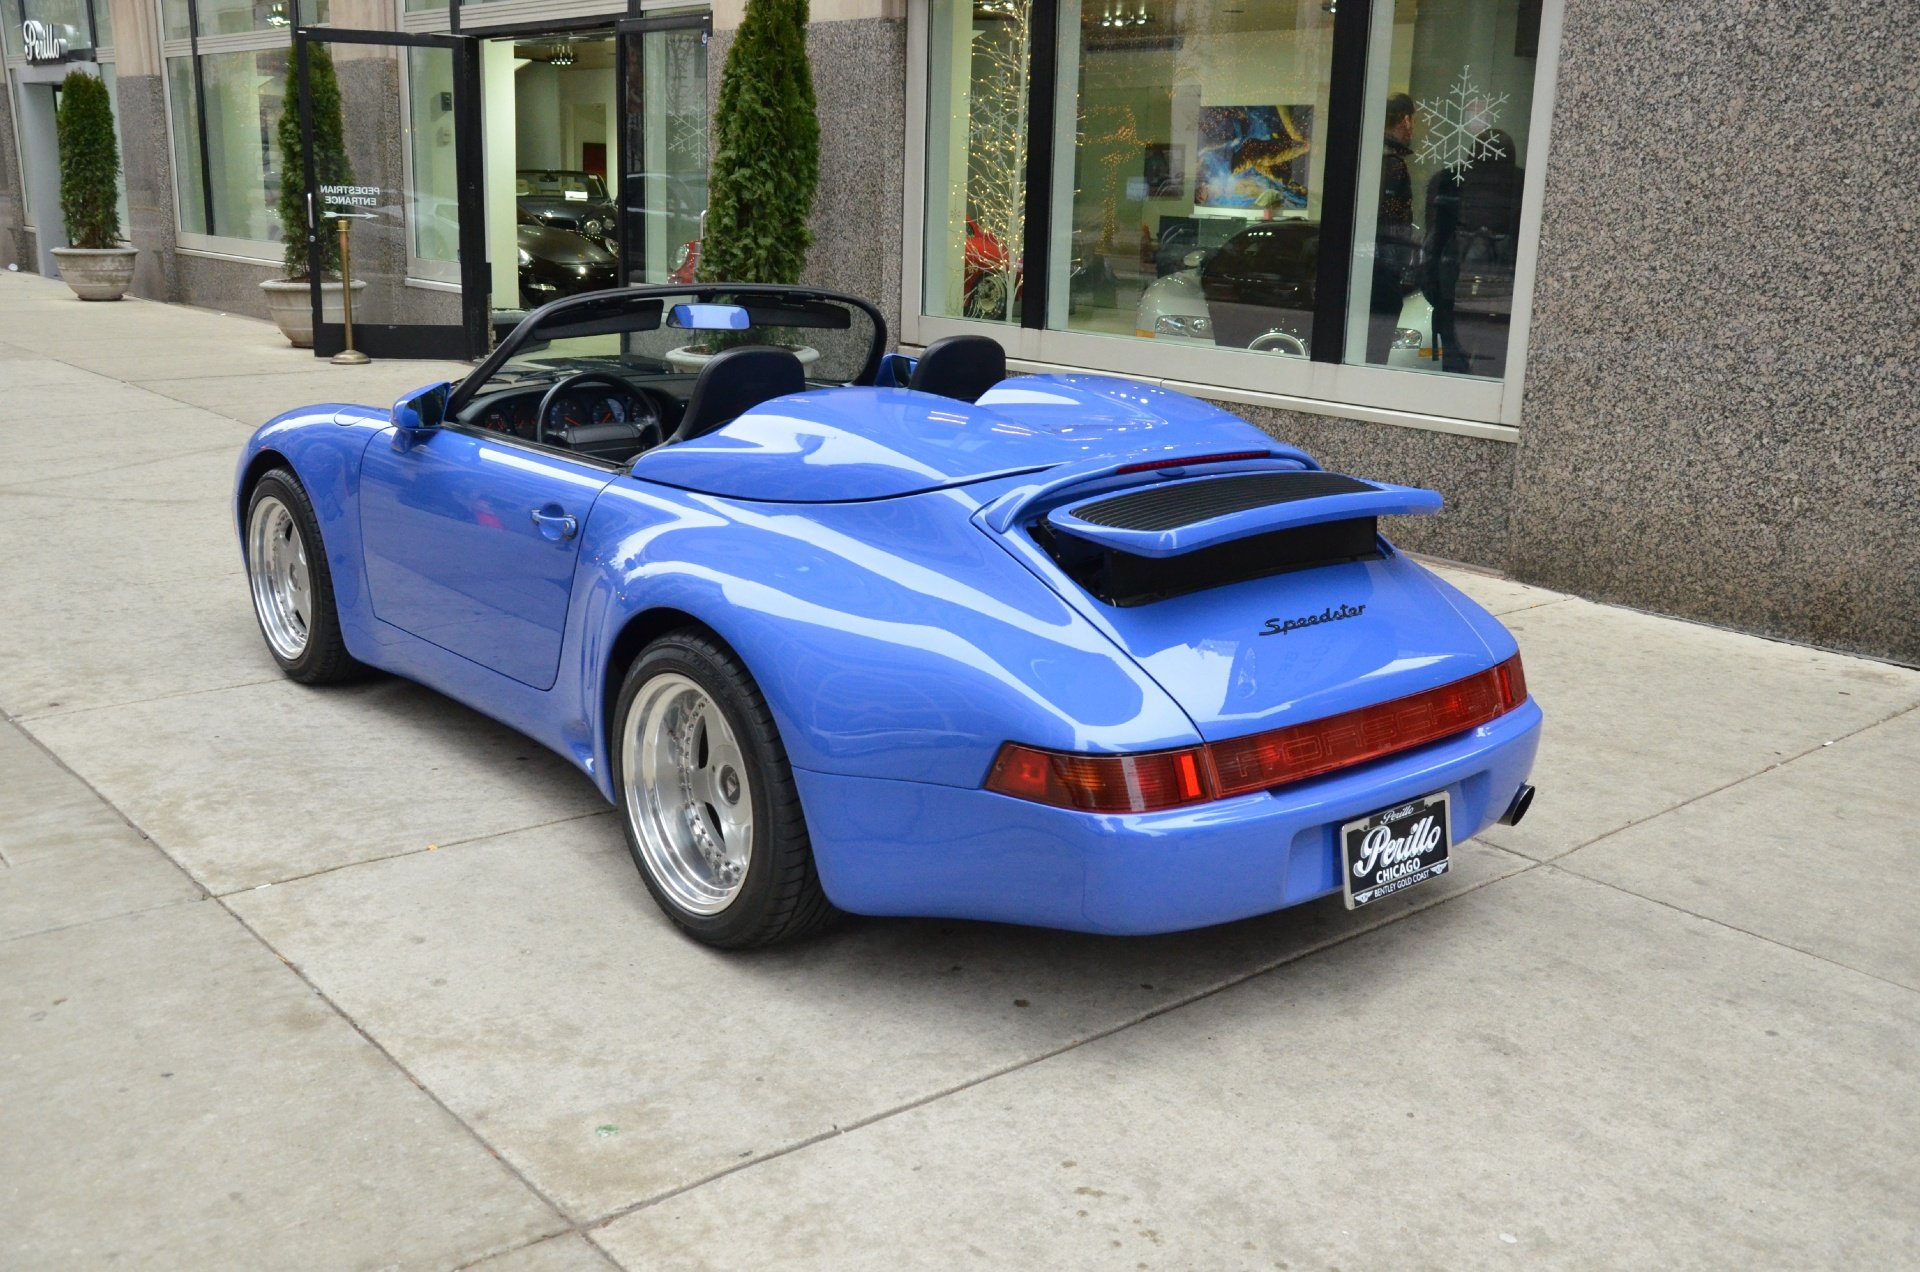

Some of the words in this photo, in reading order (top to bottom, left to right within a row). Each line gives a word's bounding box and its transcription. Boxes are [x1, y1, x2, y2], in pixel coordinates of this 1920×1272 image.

[23, 20, 60, 60] Perillo
[1259, 604, 1366, 636] Speedster
[1380, 805, 1414, 825] Perillo
[1353, 816, 1441, 878] Perillo
[1374, 884, 1397, 898] BENTLEY
[1397, 877, 1412, 889] GOLD
[1413, 871, 1430, 883] COAST
[1376, 858, 1421, 884] CHICAGO
